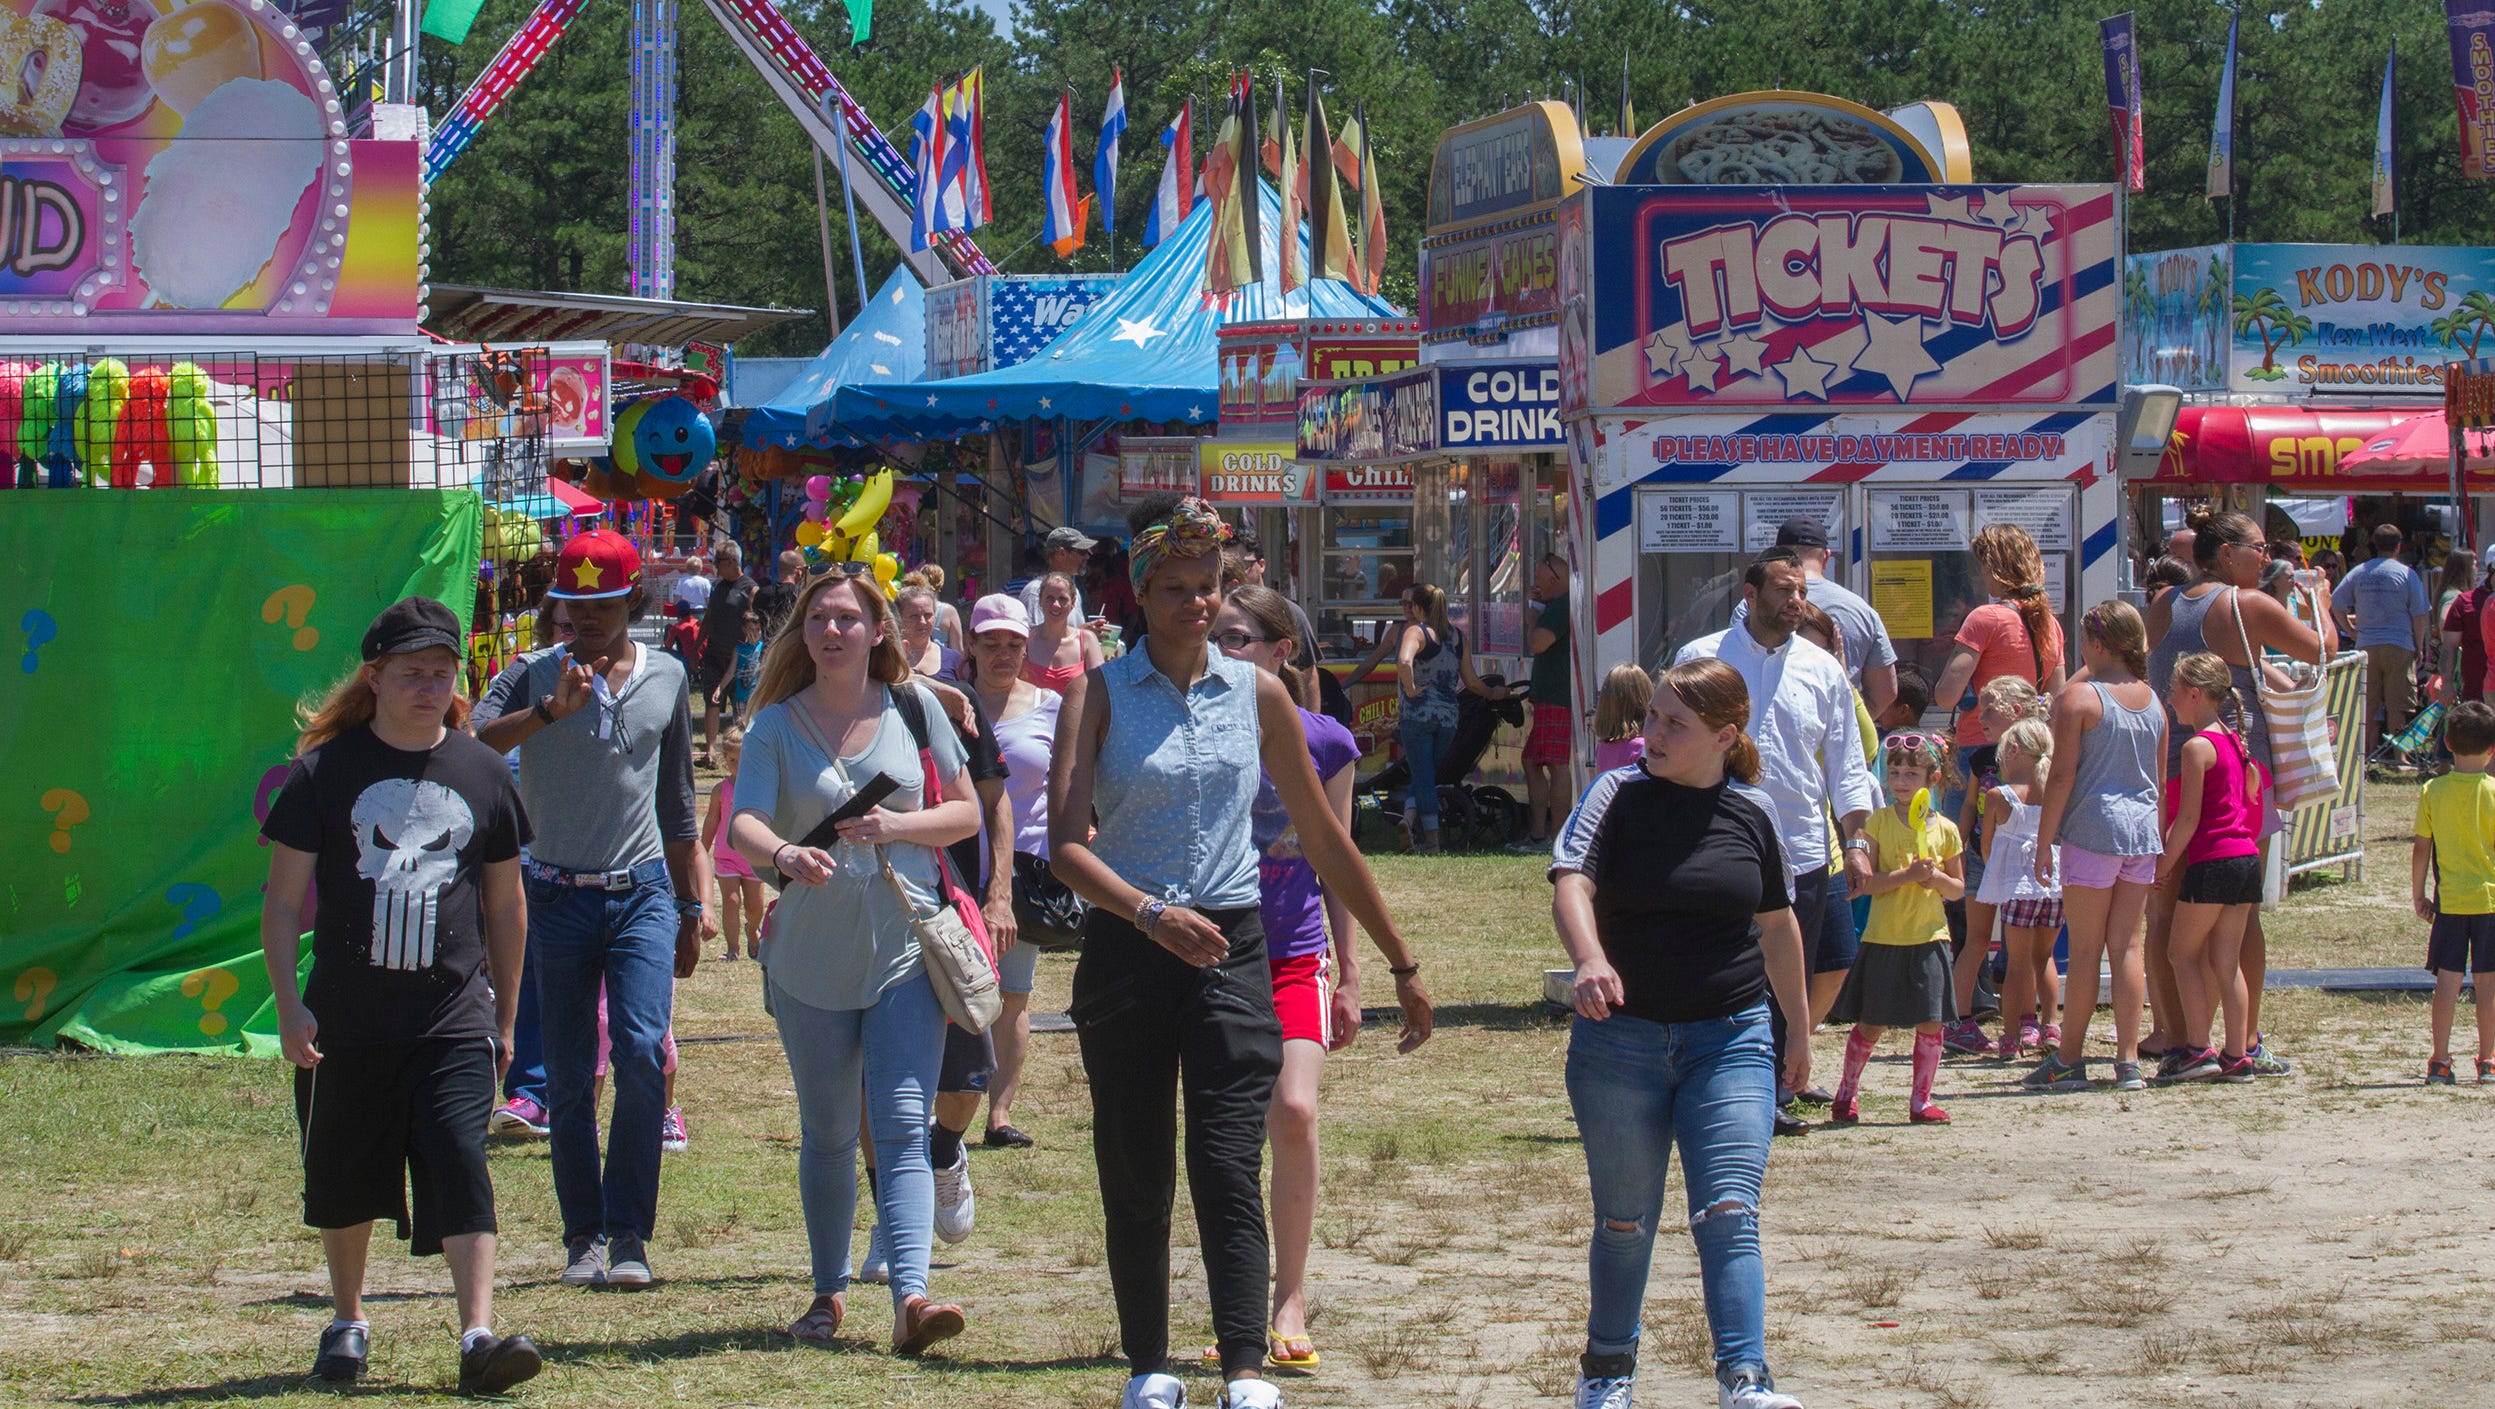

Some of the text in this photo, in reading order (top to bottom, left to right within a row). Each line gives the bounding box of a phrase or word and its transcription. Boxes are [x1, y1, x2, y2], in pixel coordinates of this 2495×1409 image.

[2470, 33, 2495, 172] SMOOTHIES
[1453, 128, 1530, 207] ELEPHANT EARS
[1434, 232, 1555, 308] FUNNEL CAKES
[1662, 212, 2045, 341] TICKETS
[2296, 262, 2448, 311] KODY'S
[2318, 321, 2426, 347] Key West
[1467, 370, 1560, 403] COLD
[2297, 355, 2446, 386] Smoothies
[1448, 410, 1569, 444] DRINK
[1222, 453, 1283, 473] COLD
[1657, 433, 2061, 465] PLEASE HAVE PAYMENT READY
[1210, 473, 1297, 493] DRINKS
[1359, 697, 1399, 724] CHILI C
